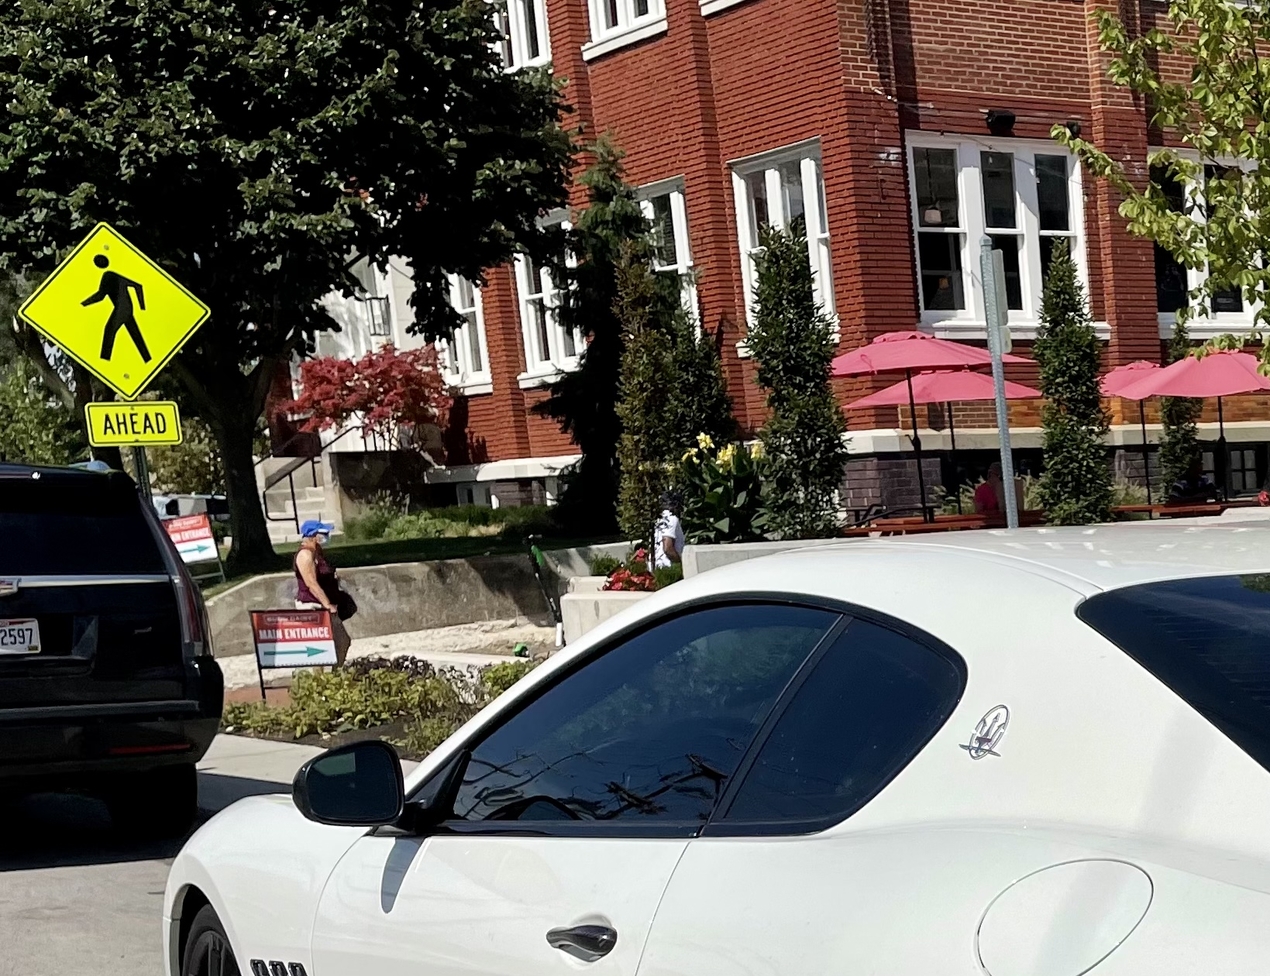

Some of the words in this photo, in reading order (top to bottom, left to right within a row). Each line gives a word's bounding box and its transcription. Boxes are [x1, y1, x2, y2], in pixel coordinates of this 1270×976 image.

[103, 411, 167, 436] AHEAD
[0, 627, 33, 646] 2597
[258, 628, 283, 640] MAIN
[284, 626, 330, 640] ENTRANCE
